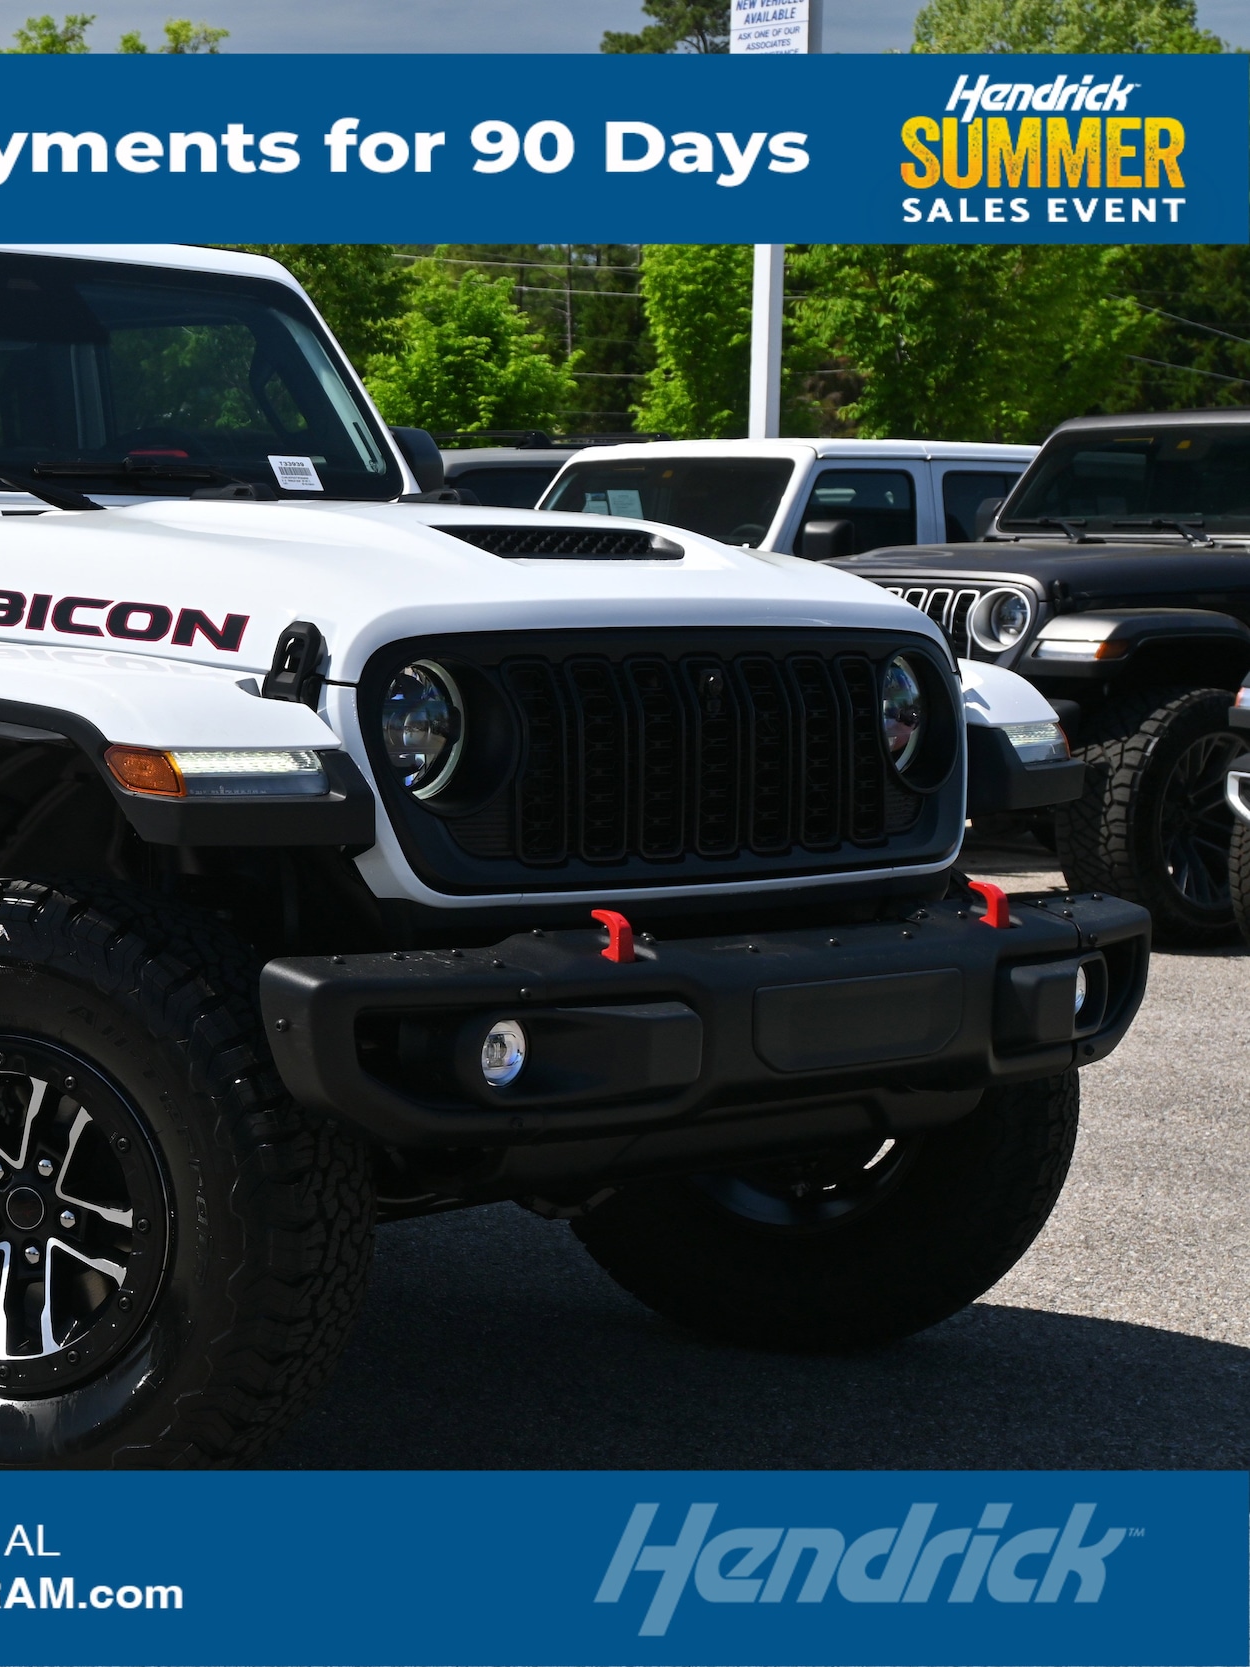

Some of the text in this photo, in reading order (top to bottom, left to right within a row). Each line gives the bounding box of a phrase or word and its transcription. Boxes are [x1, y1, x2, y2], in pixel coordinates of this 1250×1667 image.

[744, 7, 797, 25] AVAILABLE
[737, 26, 801, 41] ASK ONE OF OUR
[746, 38, 792, 51] ASSOCIATES
